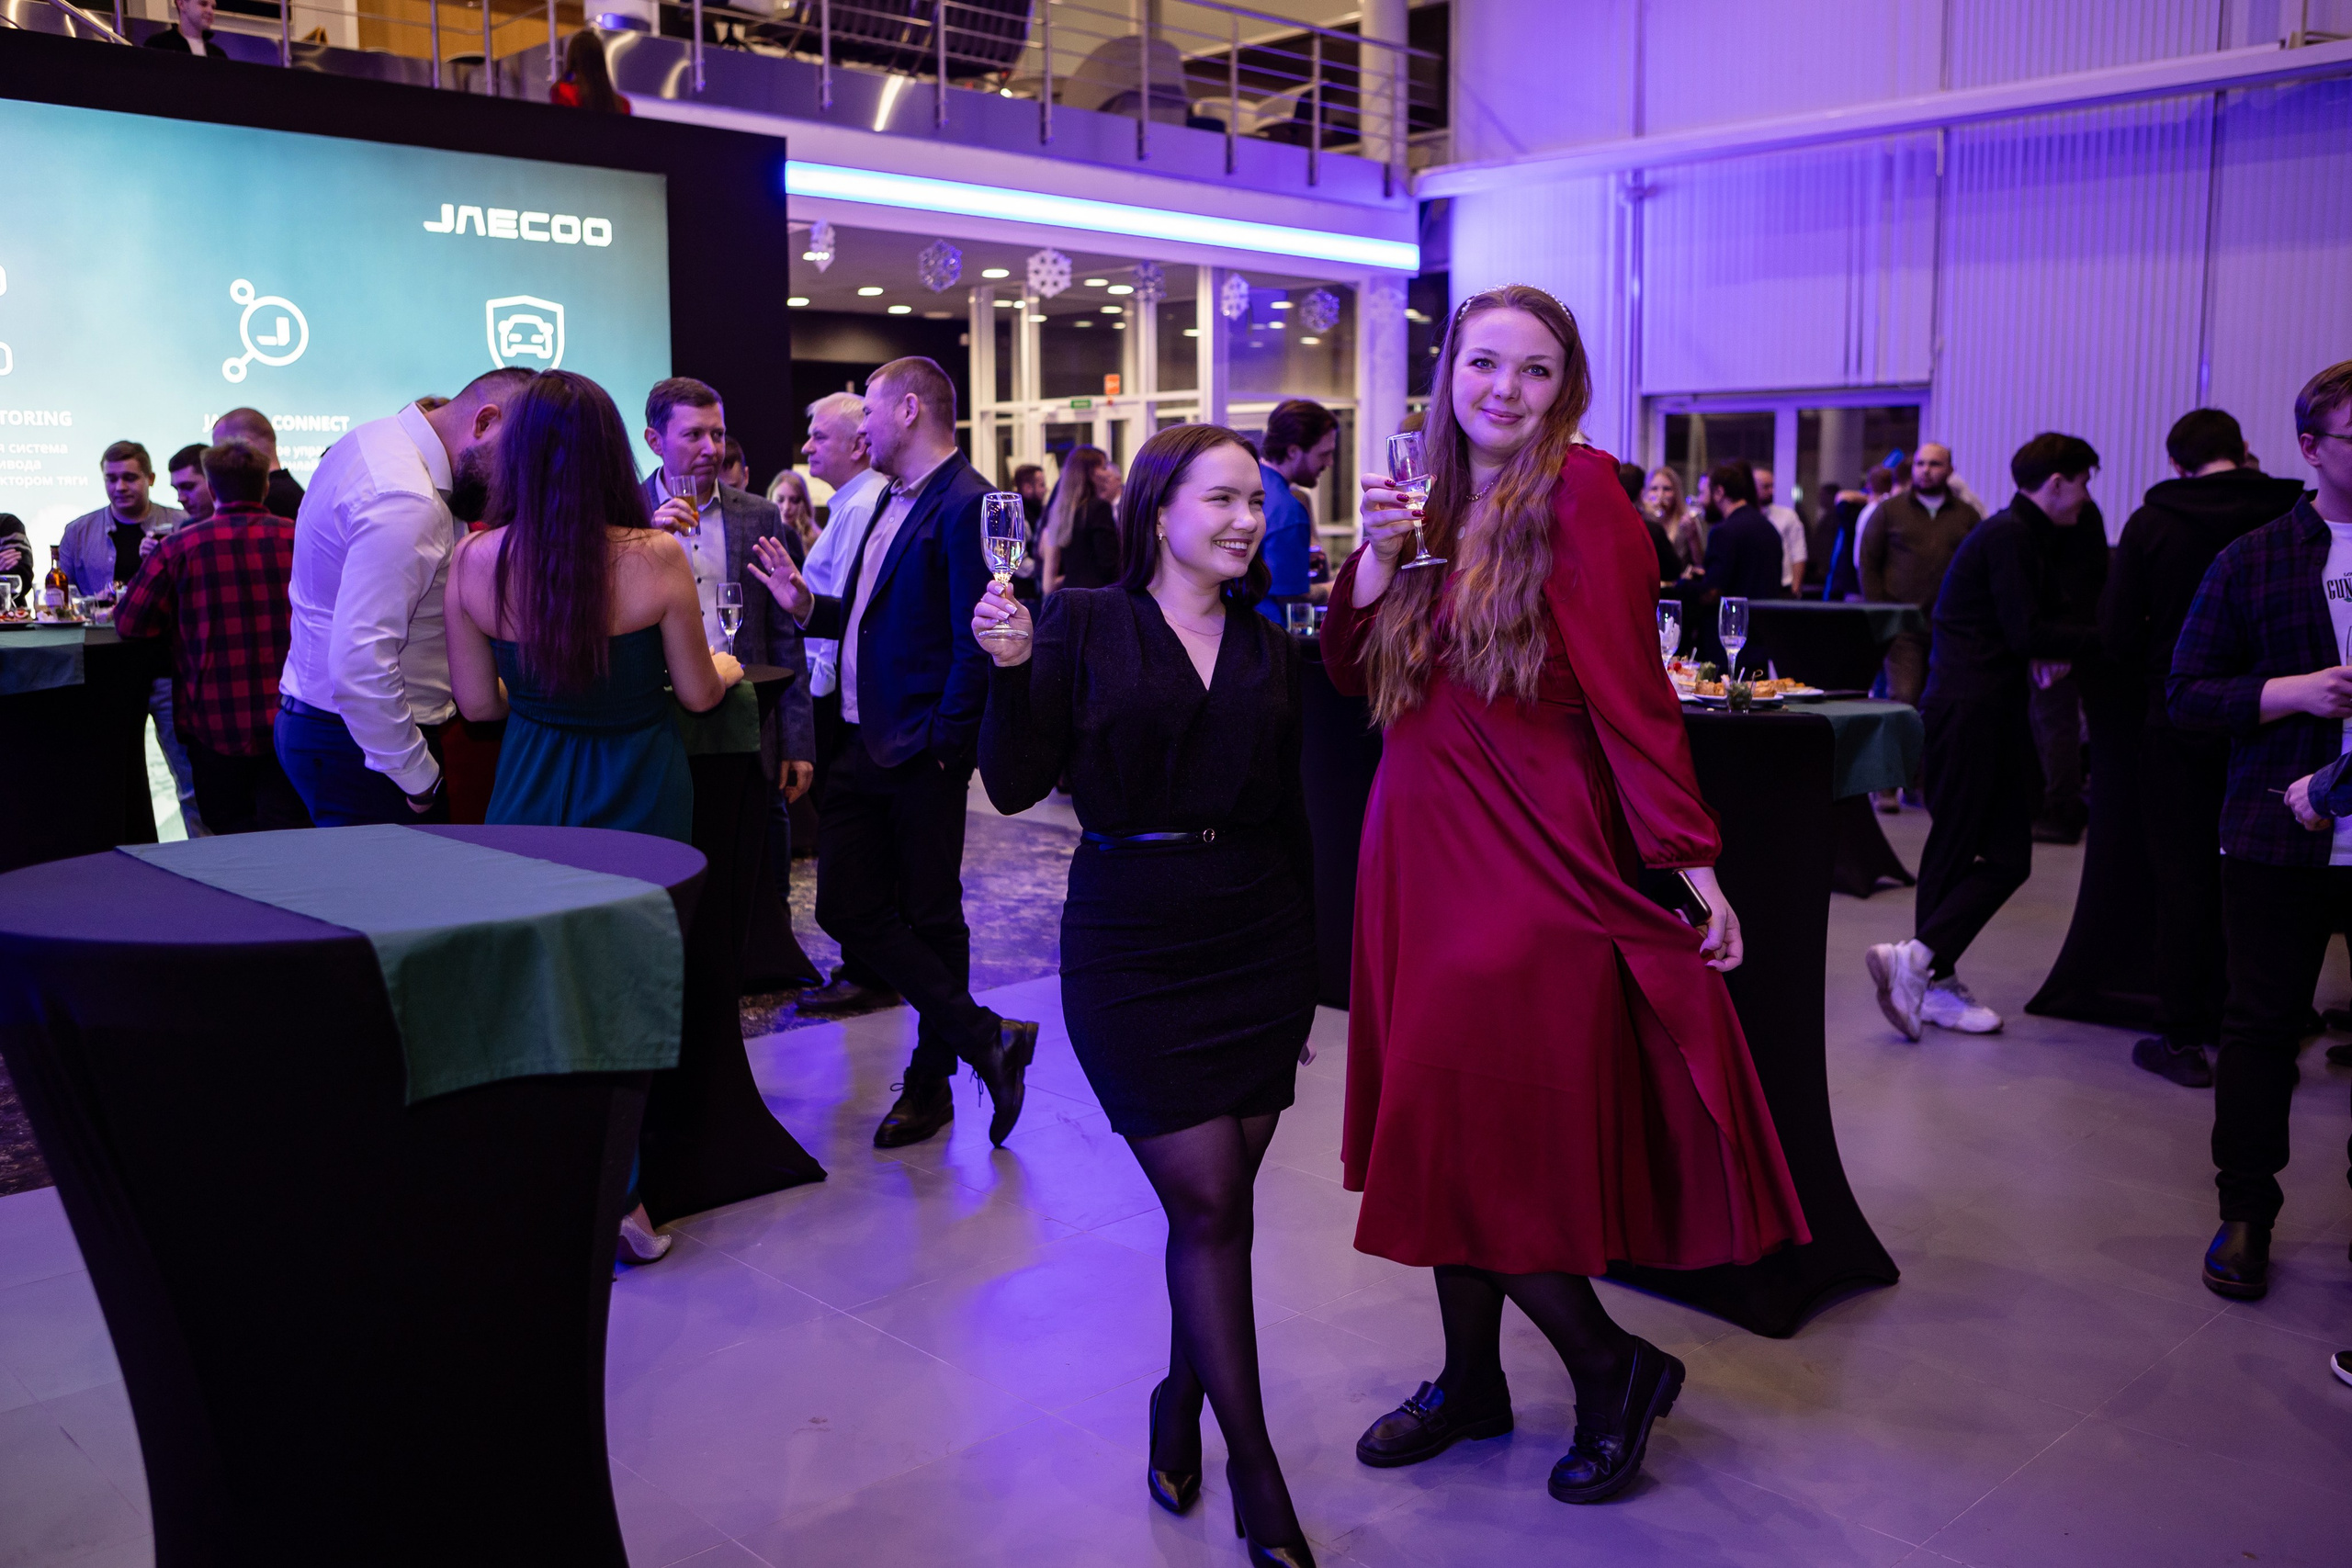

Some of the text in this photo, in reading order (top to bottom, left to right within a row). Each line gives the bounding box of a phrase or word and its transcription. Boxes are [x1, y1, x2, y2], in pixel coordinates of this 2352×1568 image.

[423, 203, 613, 247] JAECOO
[0, 410, 73, 426] TORING
[272, 415, 349, 432] CONNECT
[8, 444, 68, 454] система
[56, 476, 88, 486] тяги
